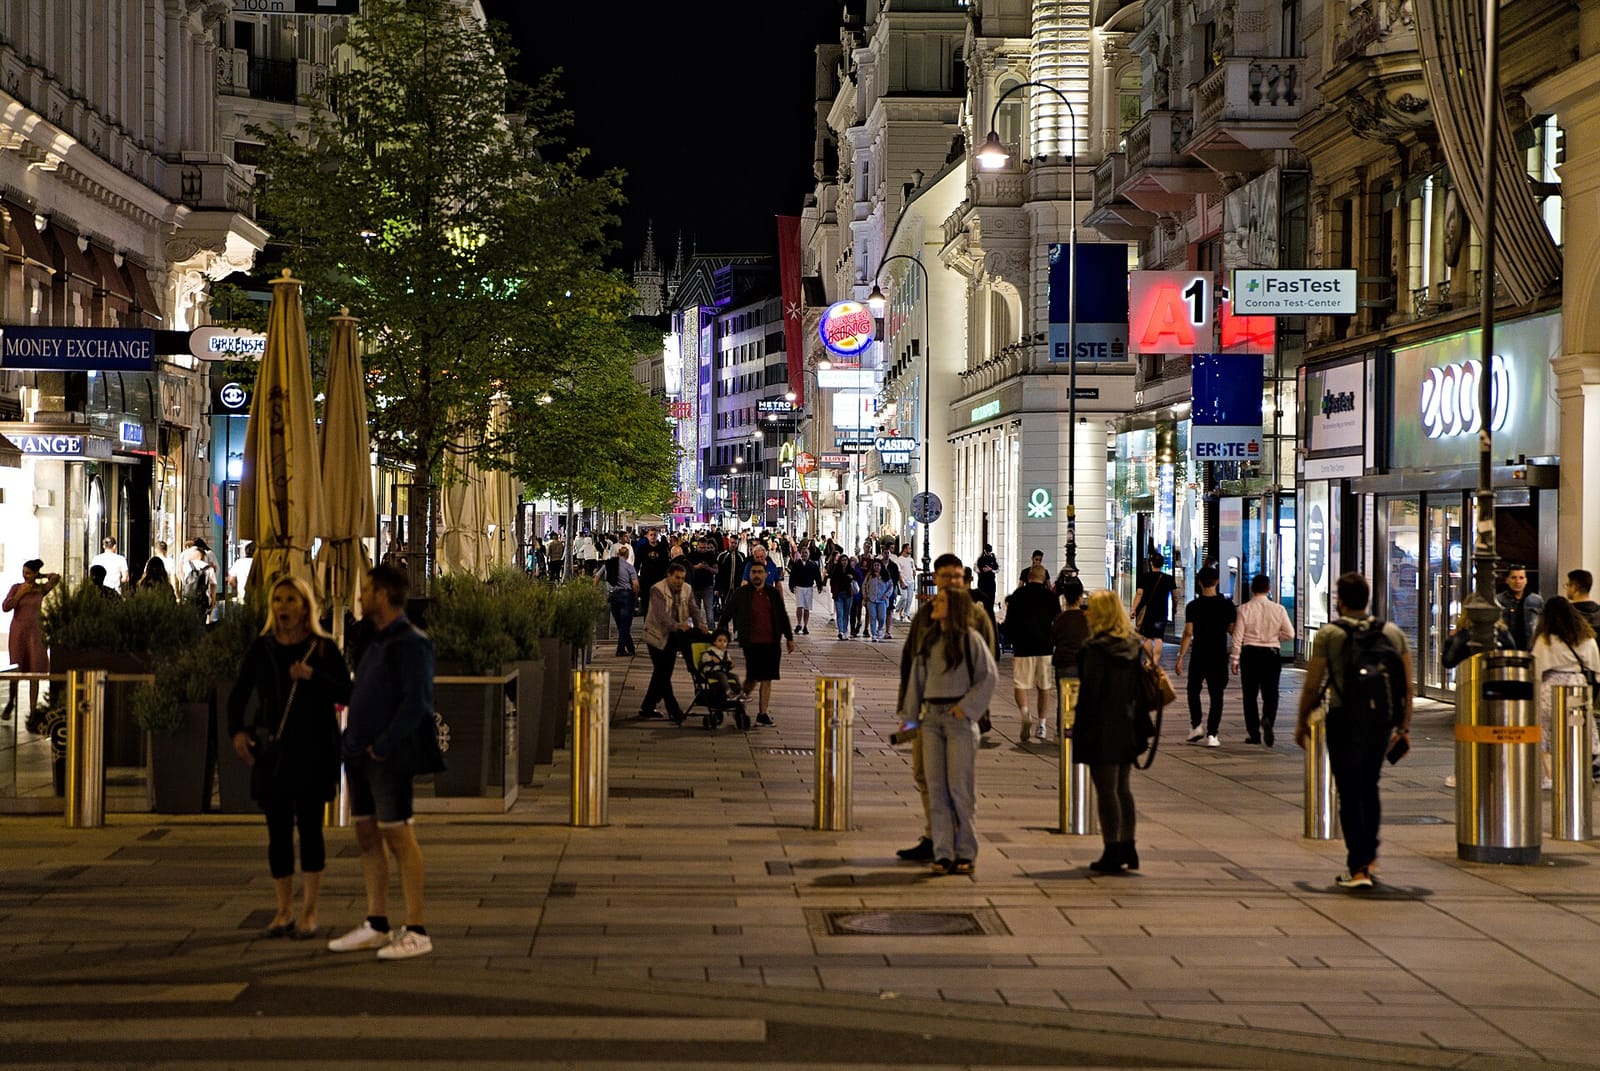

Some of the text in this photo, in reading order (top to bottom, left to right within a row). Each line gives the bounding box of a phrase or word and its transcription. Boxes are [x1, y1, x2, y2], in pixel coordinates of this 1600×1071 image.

[1265, 278, 1341, 293] FasTest
[1140, 279, 1205, 345] A1
[828, 320, 870, 344] KING
[6, 338, 150, 359] MONEY EXCHANGE
[876, 438, 915, 451] CASINO
[1196, 442, 1246, 457] ERSTE
[881, 452, 909, 463] WIEN
